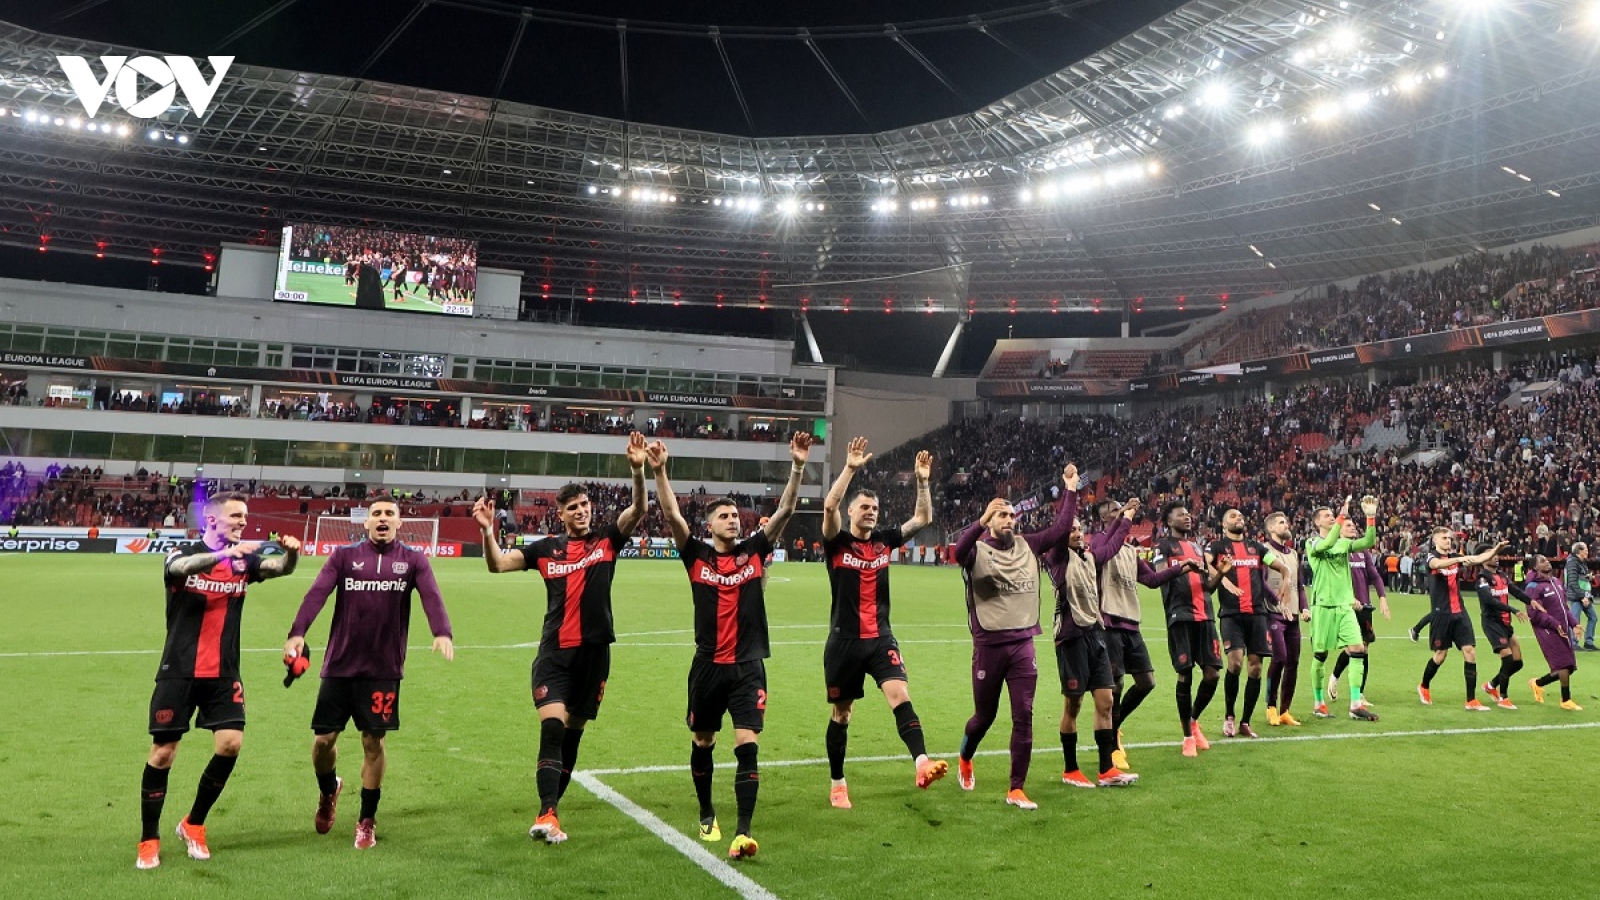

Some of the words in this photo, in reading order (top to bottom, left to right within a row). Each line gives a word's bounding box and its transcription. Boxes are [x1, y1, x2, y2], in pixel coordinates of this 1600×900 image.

[278, 291, 305, 300] 90:00
[446, 306, 470, 314] 22:55
[4, 353, 44, 364] EUROPA
[46, 356, 85, 367] LEAGUE
[342, 376, 365, 384] UEFA
[366, 378, 398, 386] EUROPA
[400, 380, 432, 388] LEAGUE
[648, 393, 669, 402] UEFA
[670, 395, 698, 403] EUROPA
[699, 397, 728, 405] LEAGUE
[842, 552, 889, 569] Barmenia
[700, 564, 755, 586] Barmenia
[345, 578, 408, 591] Barmenia
[371, 691, 396, 714] 32
